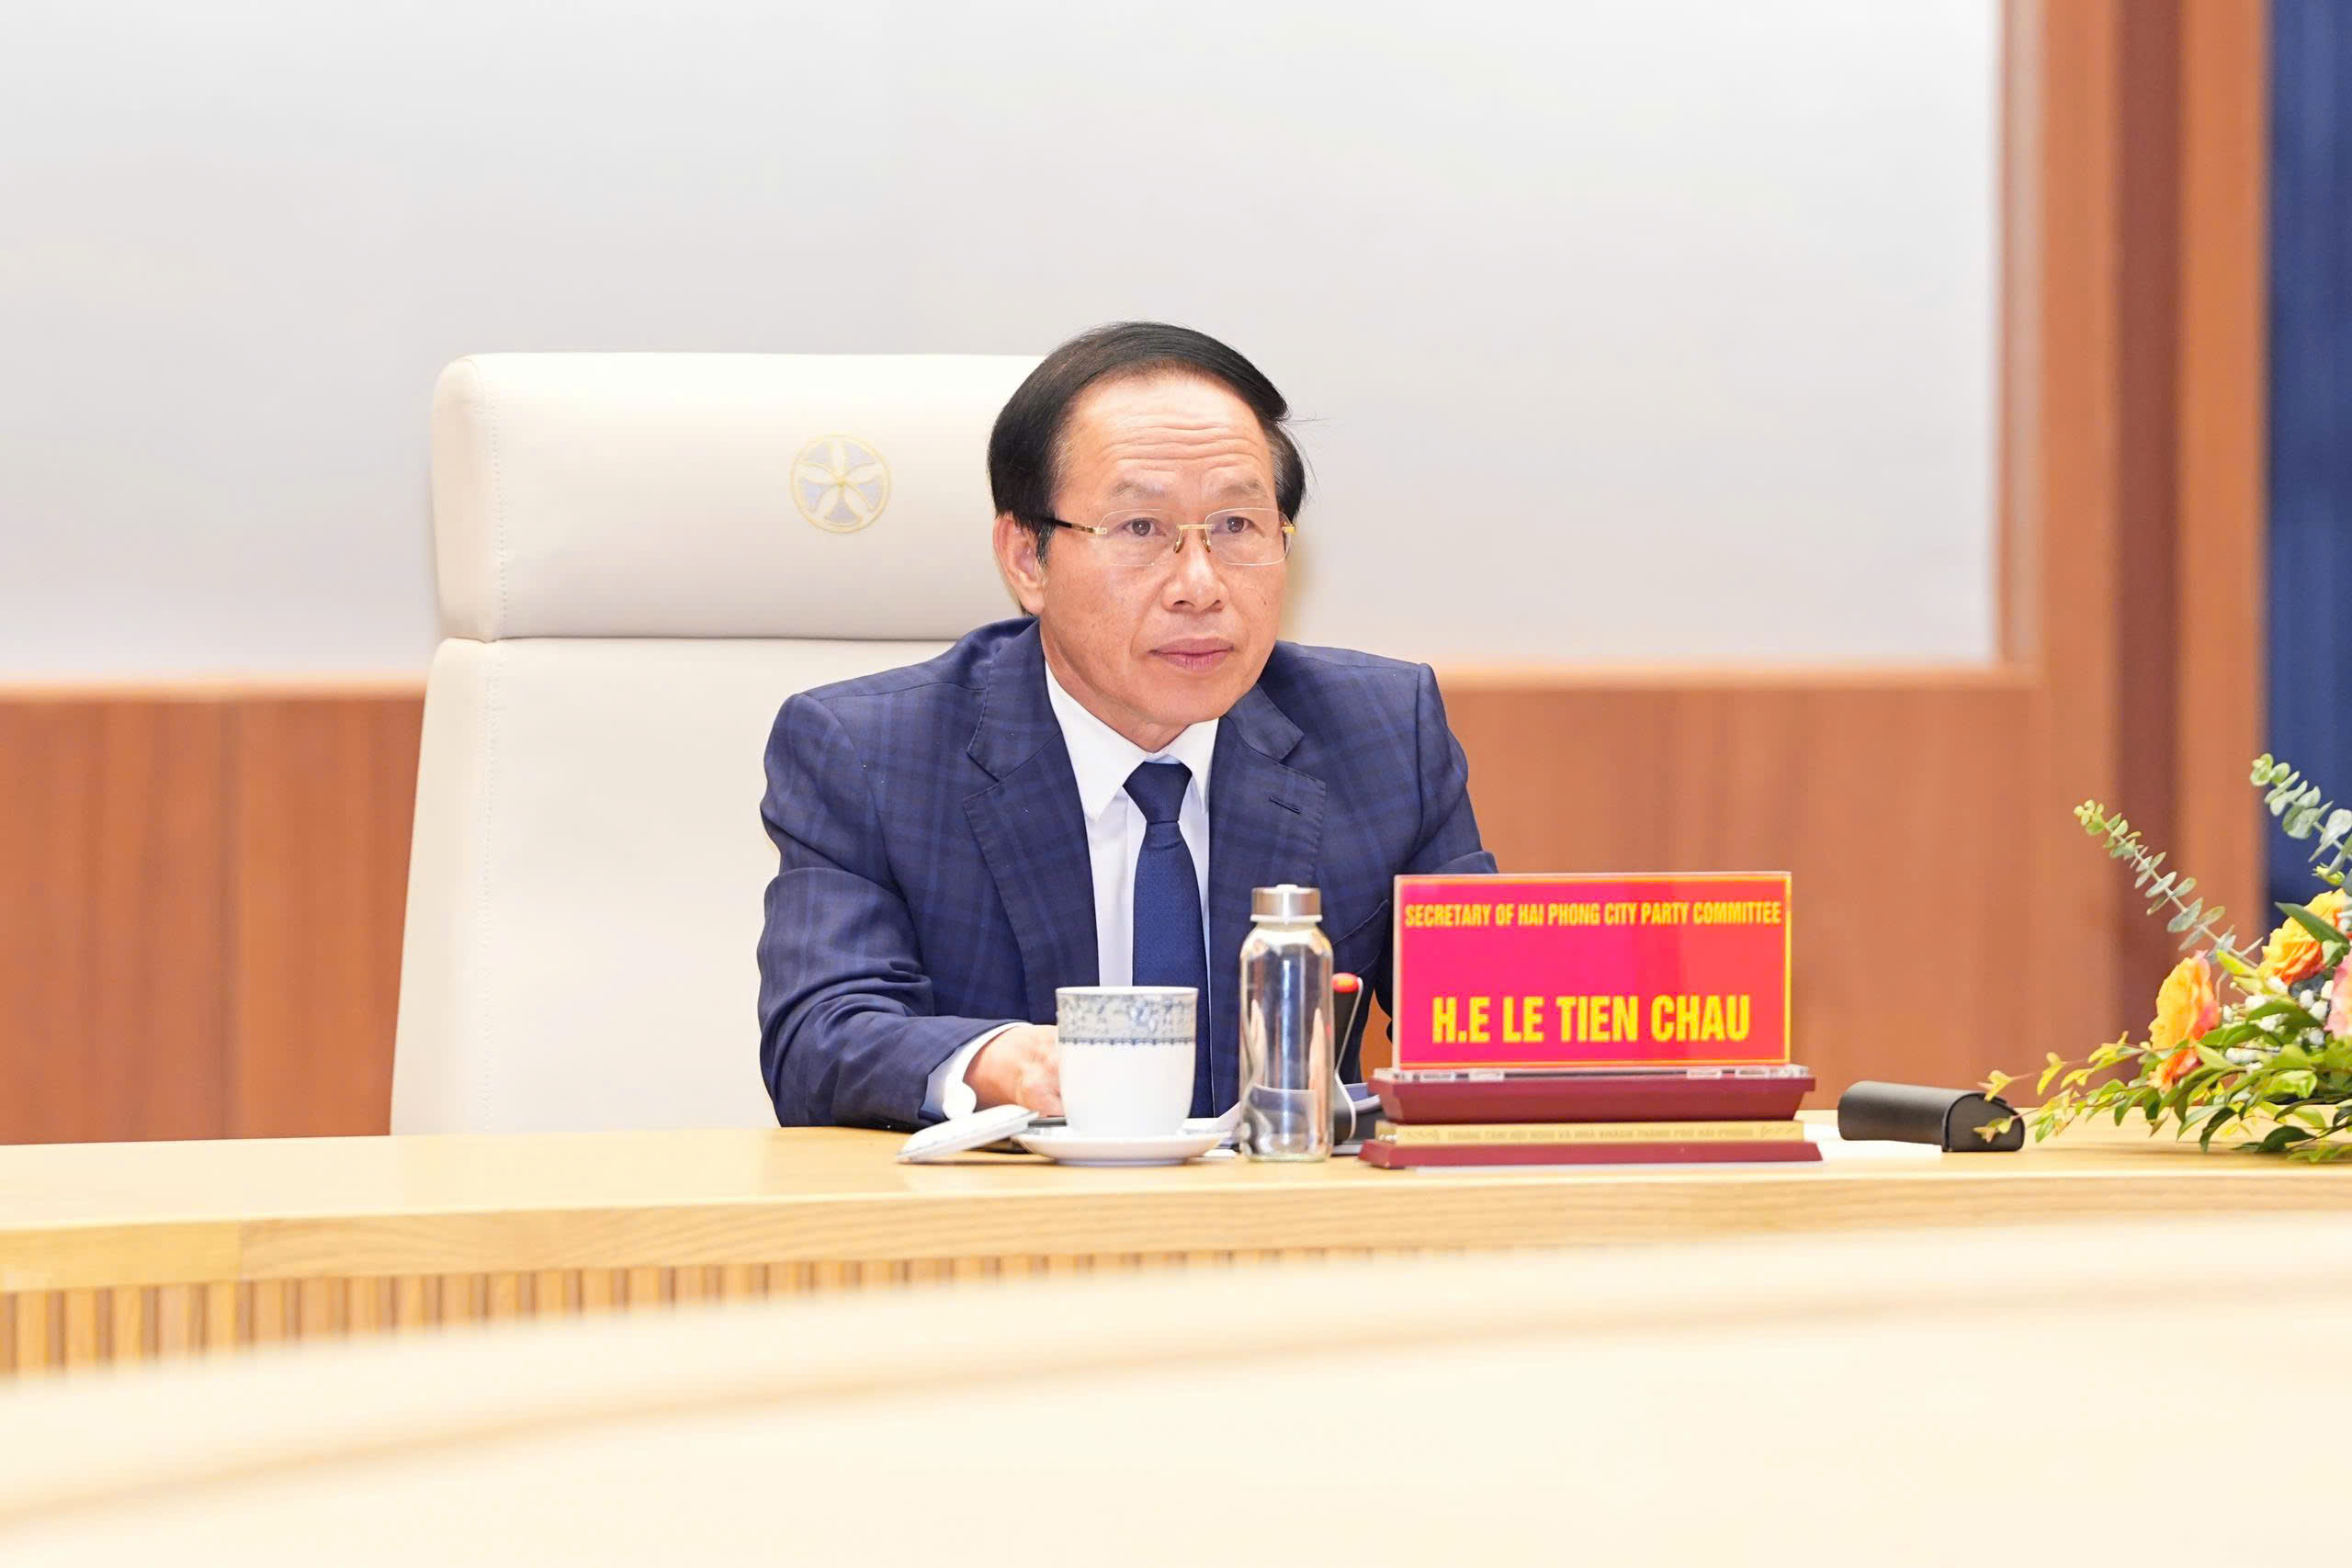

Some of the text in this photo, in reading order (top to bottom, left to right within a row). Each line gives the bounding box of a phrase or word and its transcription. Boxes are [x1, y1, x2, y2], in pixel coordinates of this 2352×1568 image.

[1405, 901, 1782, 927] SECRETARY OF HAI PHONG CITY PARTY COMMITTEE
[1432, 994, 1750, 1043] H.E LE TIEN CHAU
